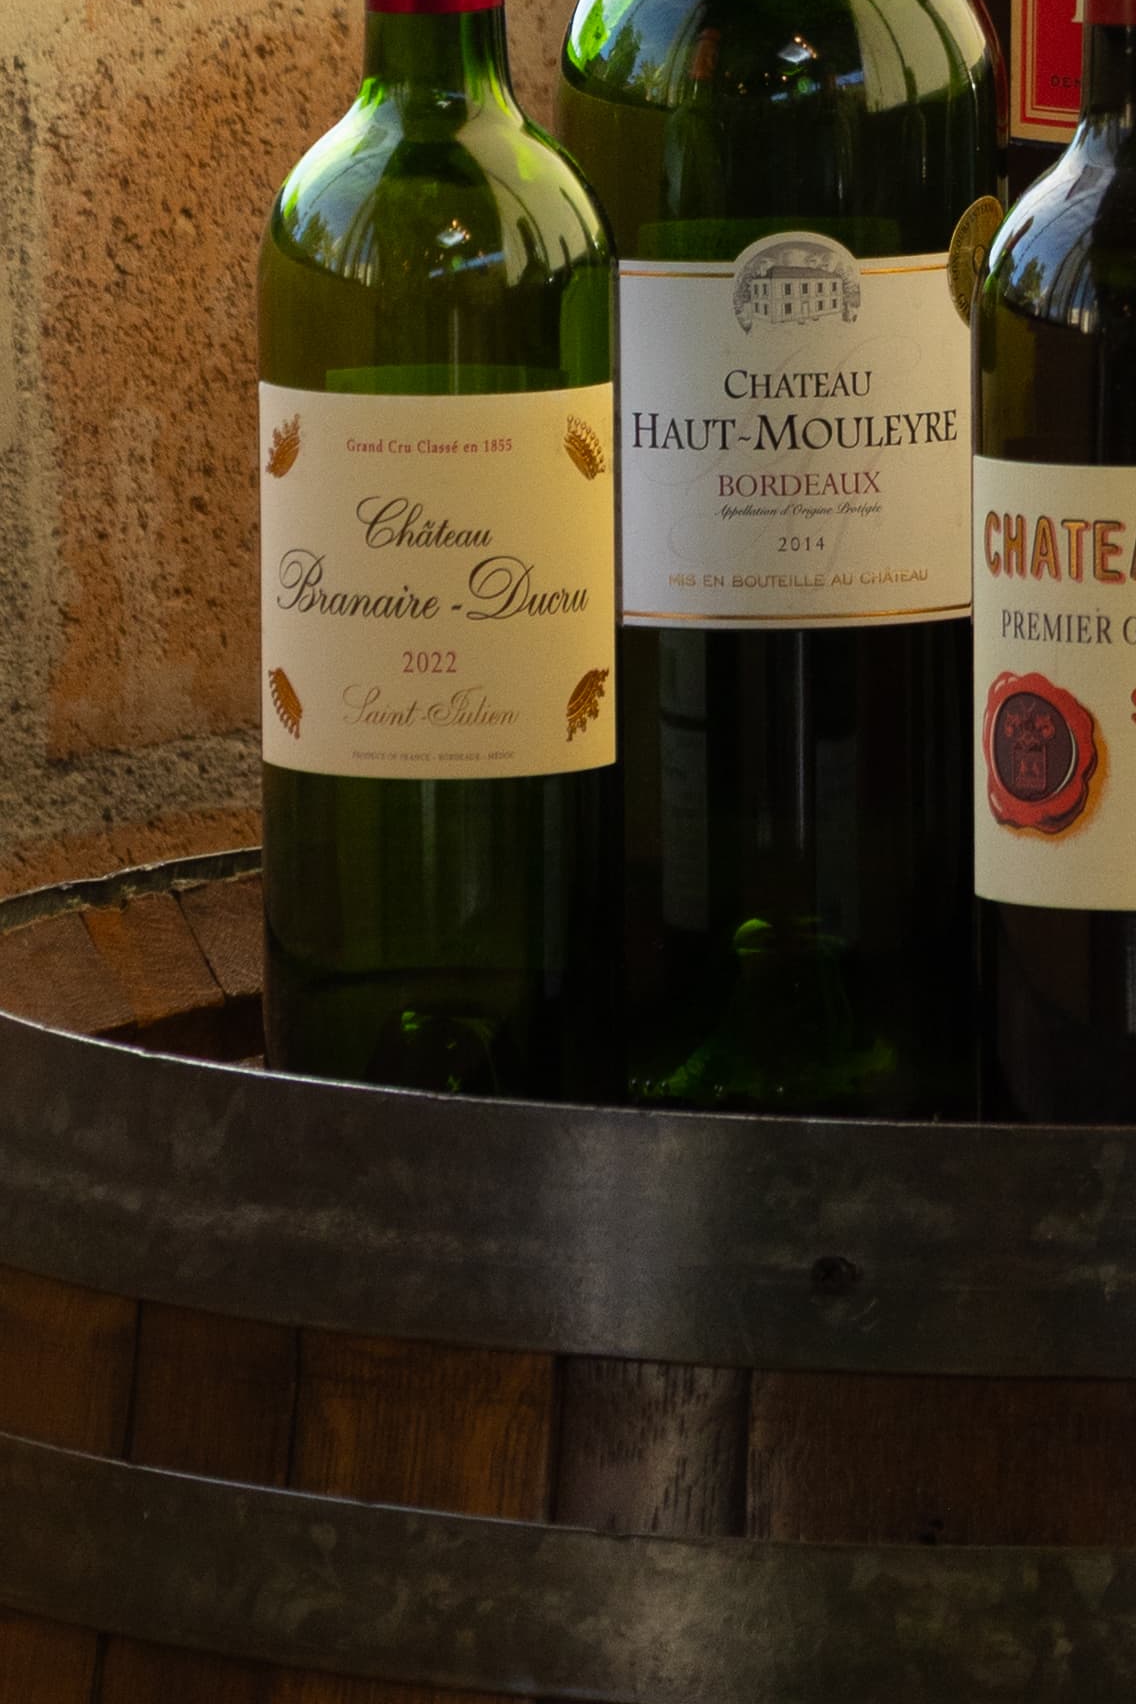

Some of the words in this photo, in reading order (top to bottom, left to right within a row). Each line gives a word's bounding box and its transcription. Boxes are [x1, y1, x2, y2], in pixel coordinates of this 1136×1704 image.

[724, 369, 873, 400] CHATEAU
[346, 438, 384, 454] Grand
[388, 439, 413, 454] Cru
[417, 438, 459, 454] Classé
[463, 443, 479, 454] en
[483, 438, 513, 454] 1855
[718, 470, 882, 499] BORDEAUX
[356, 496, 493, 550] Château
[778, 536, 825, 553] 2014
[669, 574, 696, 588] MIS
[703, 574, 725, 589] EN
[732, 573, 825, 589] BOUTEILLE
[831, 572, 853, 587] AU
[1001, 608, 1113, 645] PREMIER
[403, 650, 458, 674] 2022
